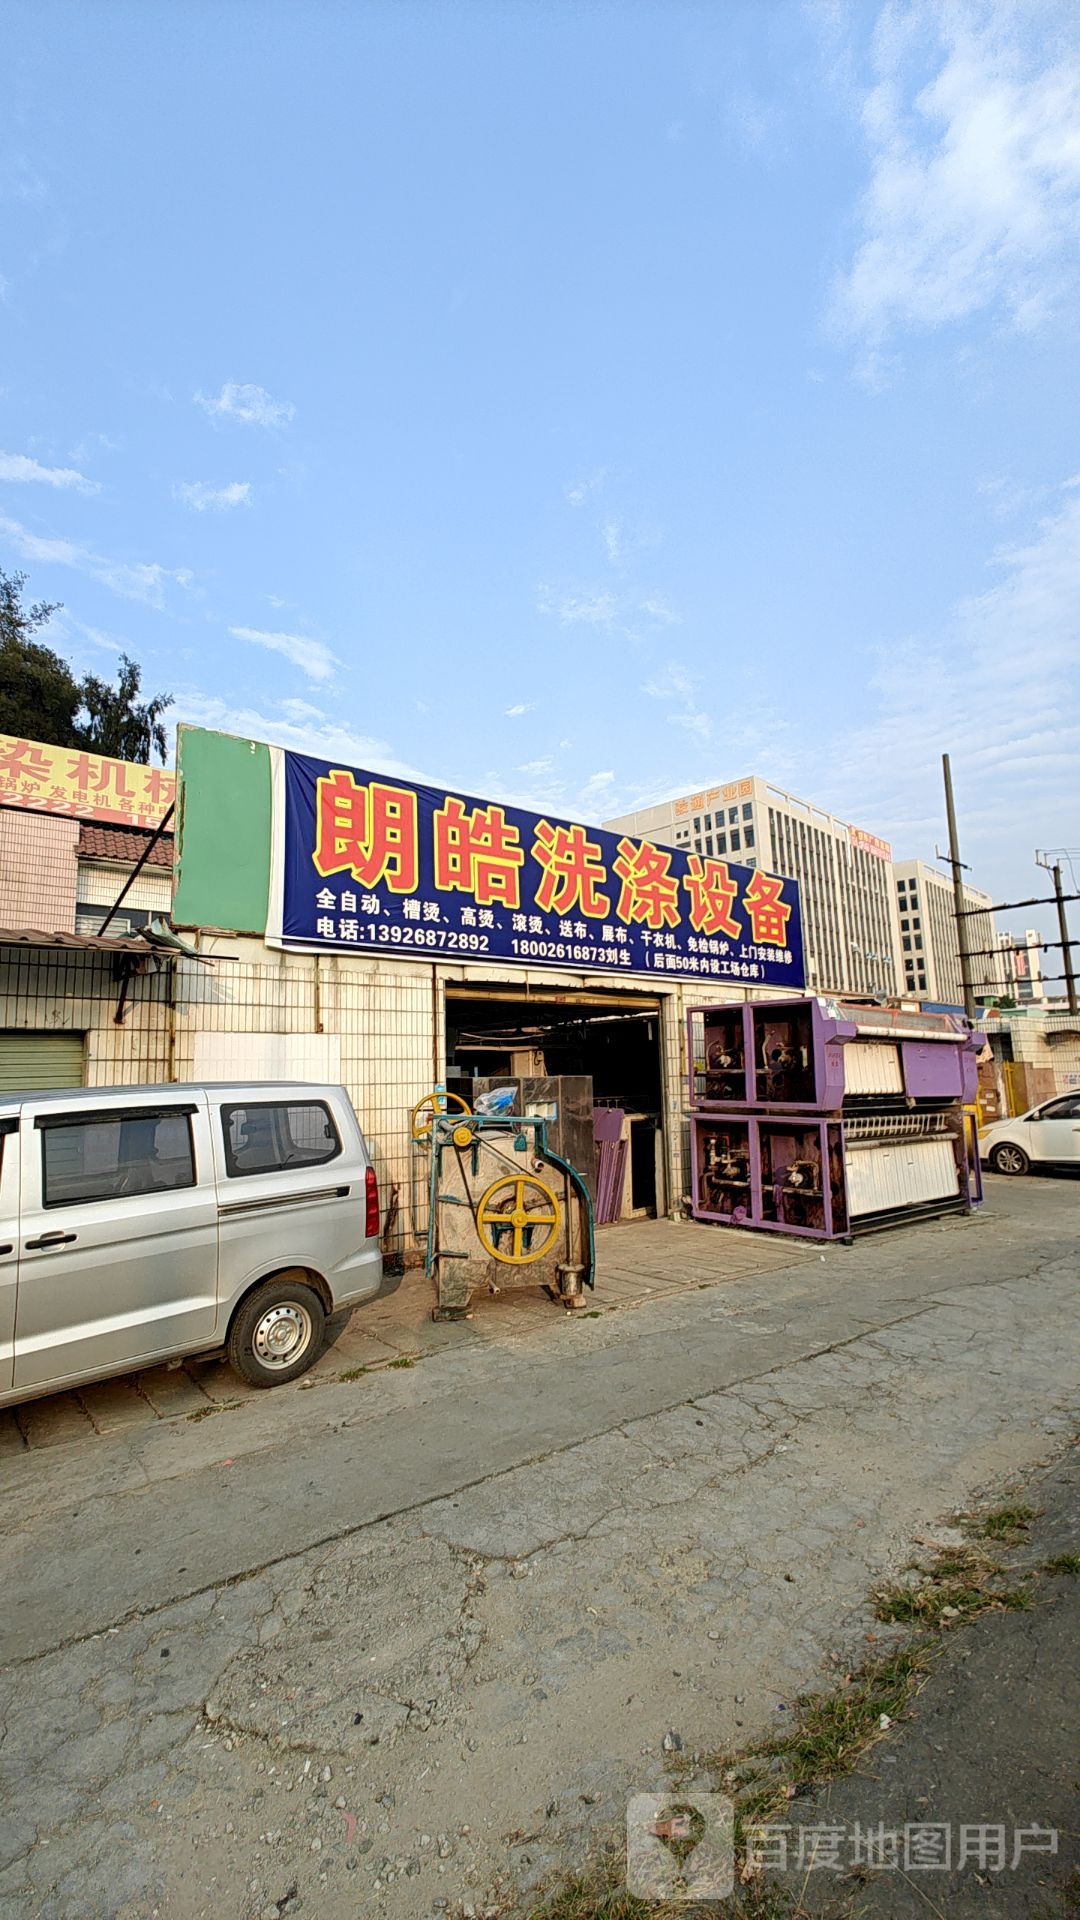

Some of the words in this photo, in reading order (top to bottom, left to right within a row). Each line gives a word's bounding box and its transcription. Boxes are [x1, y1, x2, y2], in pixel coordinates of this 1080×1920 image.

[49, 784, 112, 808] 发电机
[312, 768, 792, 948] 朗皓洗涤设备
[316, 916, 490, 952] 电话:13926872892
[511, 938, 632, 966] 18002616873刘生
